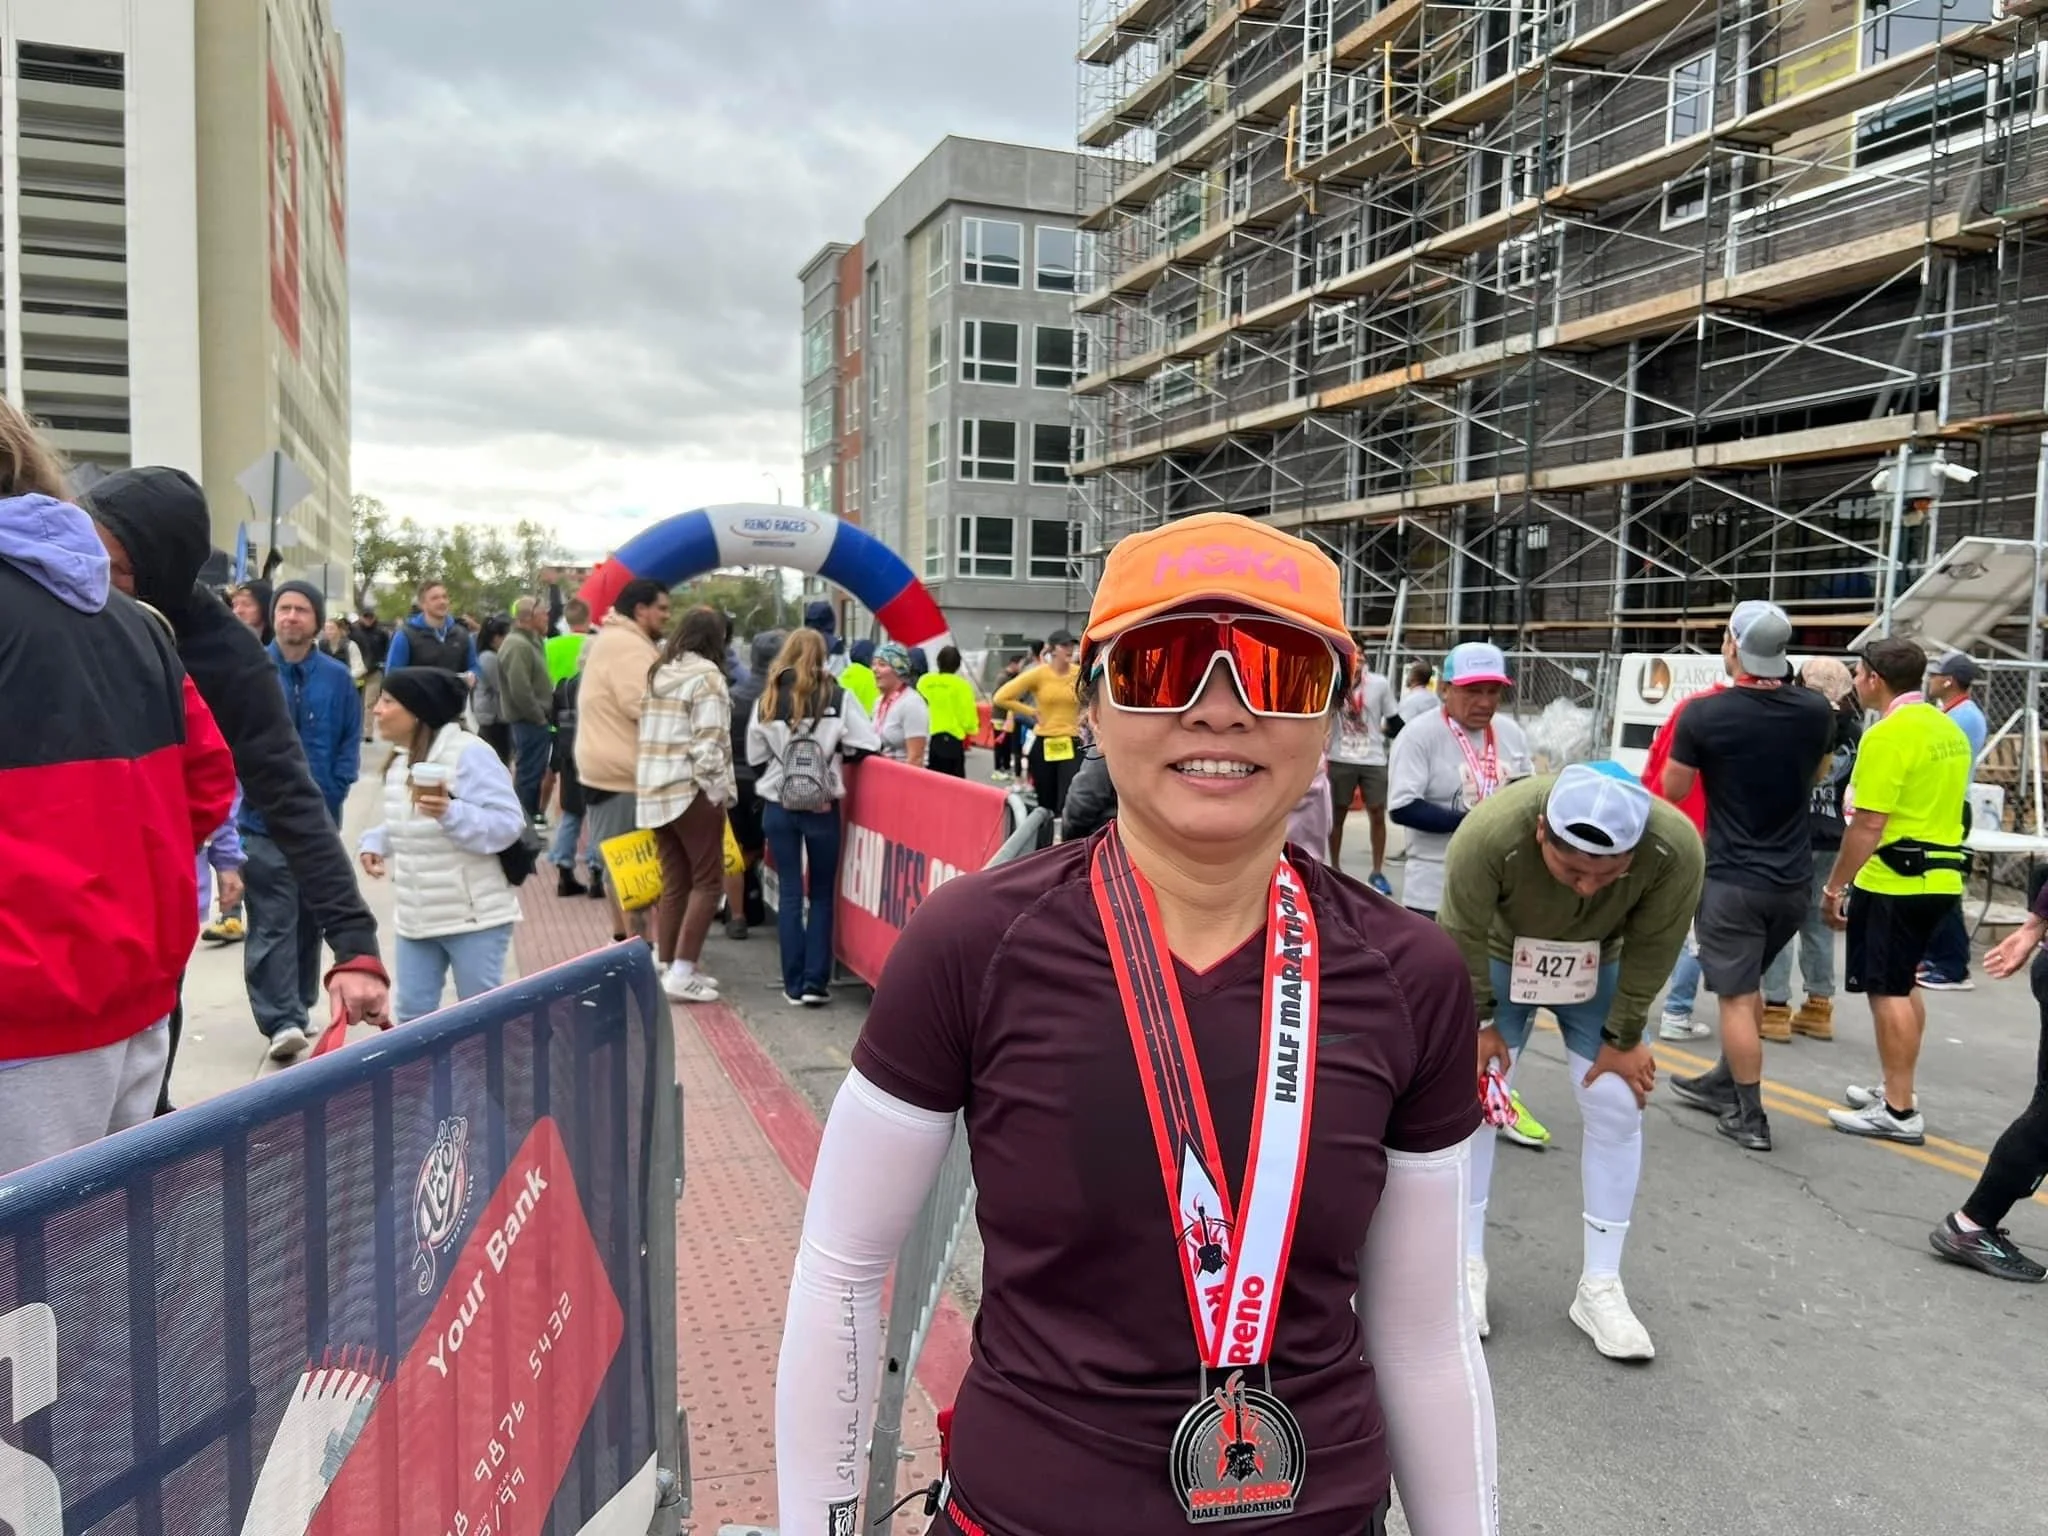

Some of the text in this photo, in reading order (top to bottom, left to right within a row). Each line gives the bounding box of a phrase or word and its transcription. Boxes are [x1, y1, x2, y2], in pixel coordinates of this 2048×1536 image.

[744, 518, 807, 533] RENO RACES
[1152, 543, 1302, 593] HOKA
[1535, 955, 1577, 978] 427
[1522, 991, 1538, 1000] 427
[1275, 1032, 1301, 1103] HALF
[427, 1165, 549, 1379] Your Bank
[474, 1400, 526, 1481] 9876
[528, 1291, 573, 1380] 5432
[1191, 1504, 1223, 1520] HALF
